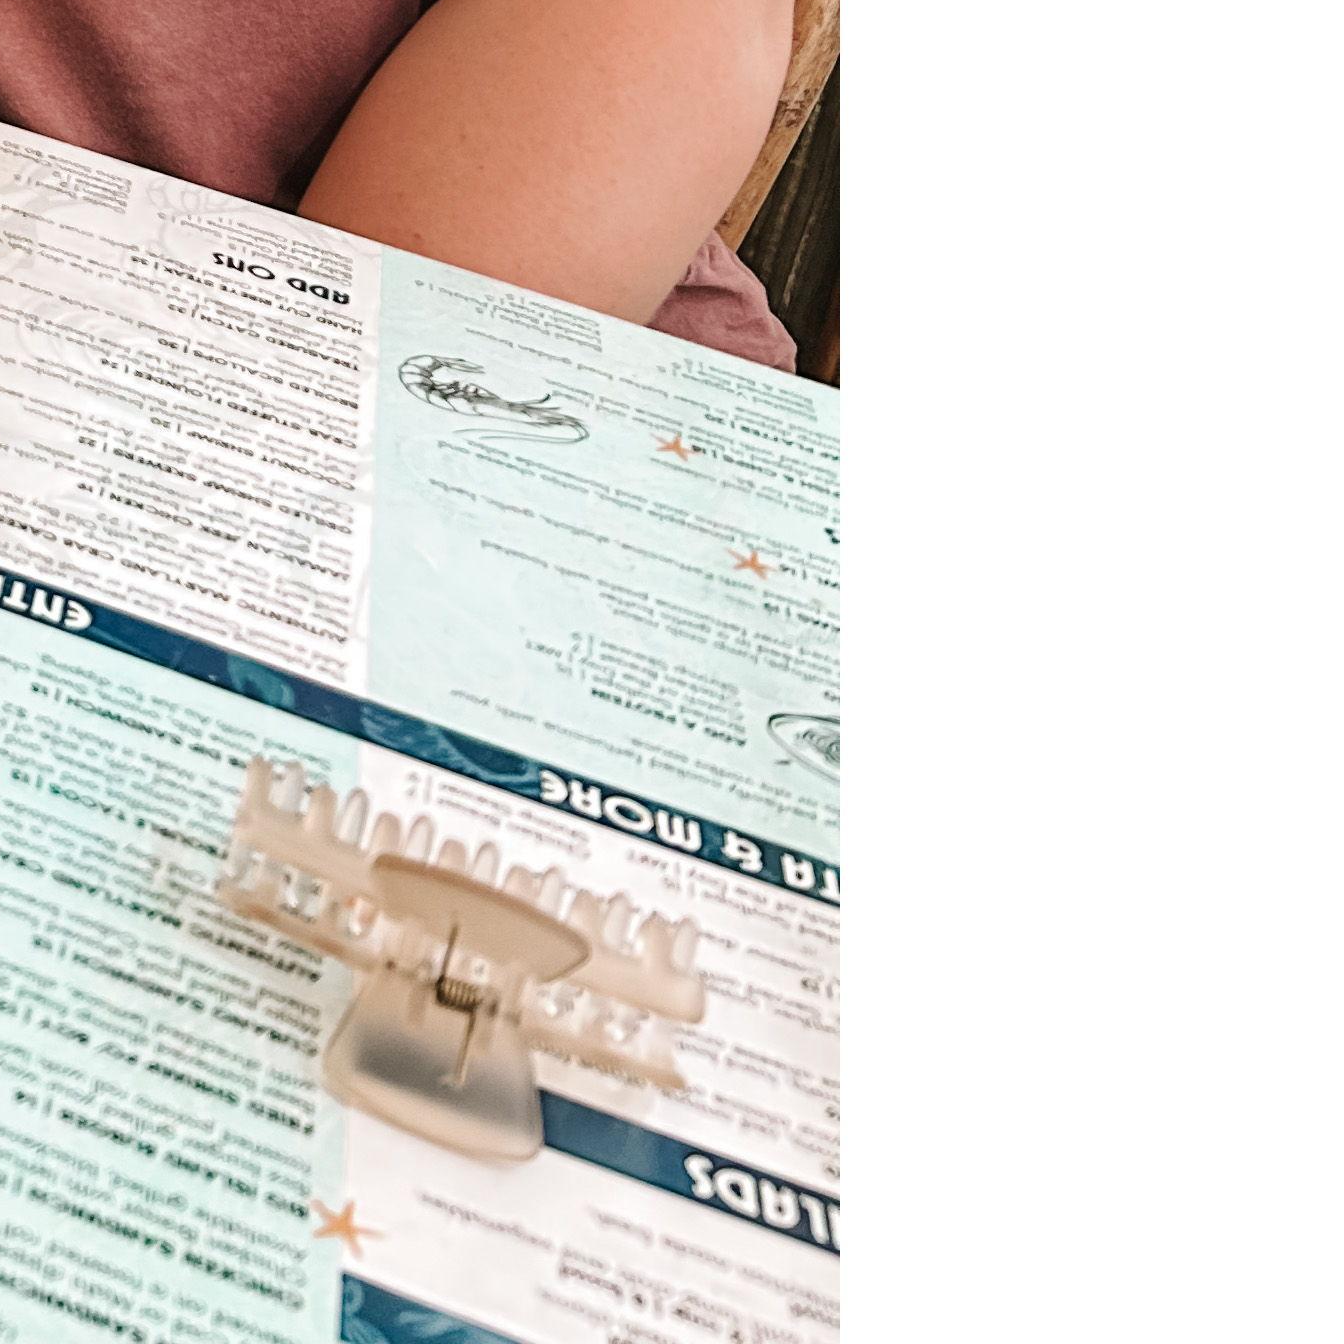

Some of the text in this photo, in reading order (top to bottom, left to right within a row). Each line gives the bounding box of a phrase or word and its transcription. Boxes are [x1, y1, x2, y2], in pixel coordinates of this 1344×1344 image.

[161, 264, 214, 288] STEAK
[209, 250, 351, 307] ADD ONS
[277, 302, 310, 318] CUT
[315, 315, 362, 336] HAND
[198, 312, 360, 373] TREASURED CATCH
[133, 368, 222, 405] FLOUNDER
[192, 347, 283, 385] SCALLOPS
[288, 380, 359, 410] BROILED
[186, 428, 255, 458] SHRIMP
[111, 446, 198, 483] SKEWERS
[260, 453, 356, 492] COCONUT
[108, 492, 193, 529] CHICKEN
[202, 477, 273, 508] SHRIMP
[277, 503, 353, 535] GRILLED
[61, 537, 114, 562] CRAB
[245, 539, 350, 582] JAMAICAN
[118, 557, 231, 603] MARYLAND
[235, 598, 347, 644] AUTHENTIC
[64, 692, 223, 762] DIP SANDWICH
[46, 780, 129, 821] TACOS
[539, 769, 703, 853] MORE
[721, 830, 763, 874] &
[50, 869, 182, 930] MARYLAND
[186, 922, 322, 984] AUTHENTIC
[69, 950, 320, 1058] CUBANO SANDWICH
[56, 1108, 160, 1159] BURGER
[245, 1099, 315, 1137] FRIED
[163, 1151, 259, 1200] ISLAND
[24, 1188, 304, 1312] CHICKEN SANDWICH
